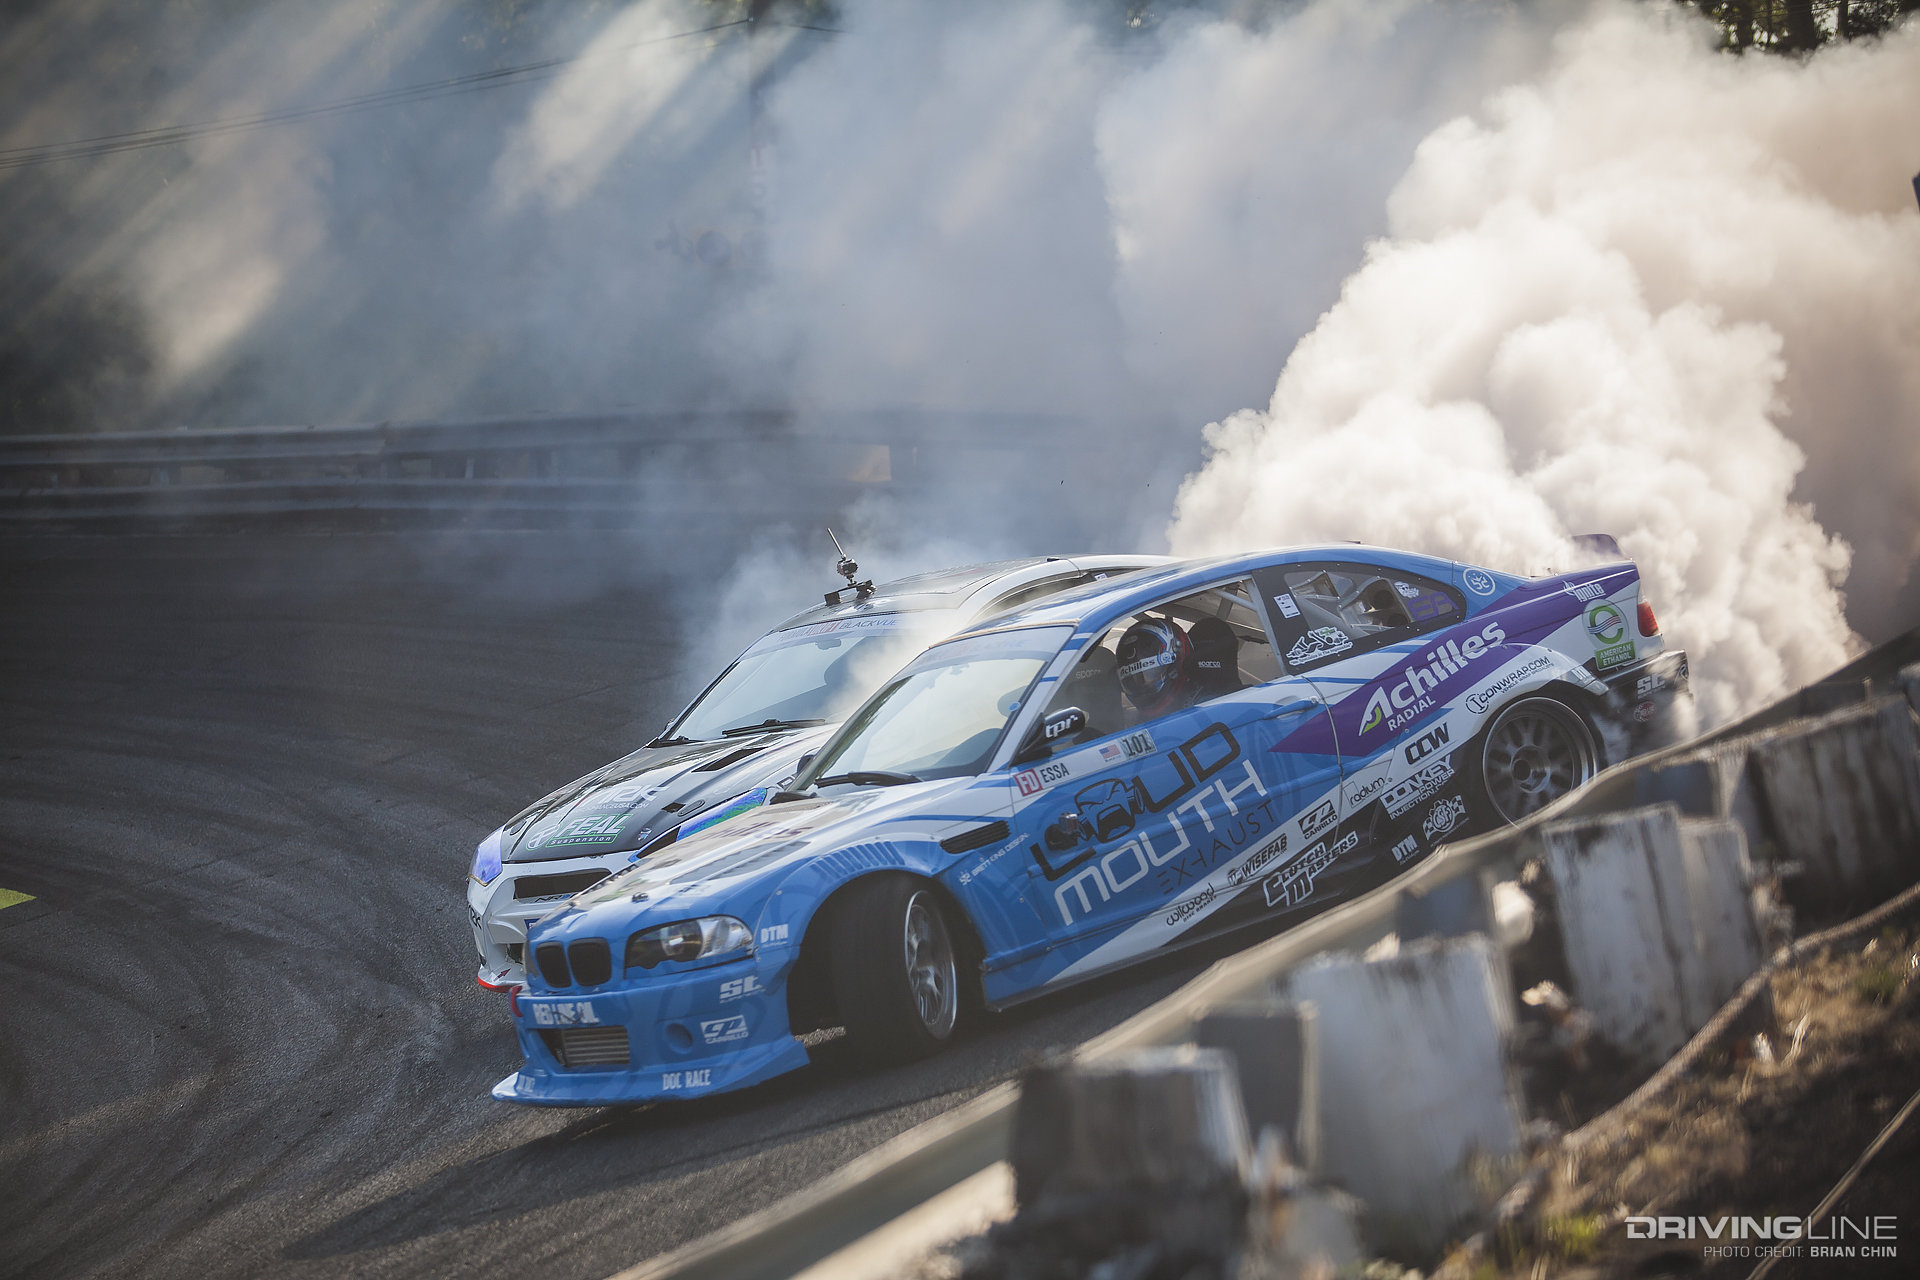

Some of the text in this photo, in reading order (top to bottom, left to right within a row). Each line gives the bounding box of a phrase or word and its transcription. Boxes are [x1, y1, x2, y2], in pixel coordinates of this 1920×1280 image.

[839, 620, 898, 629] BLACKVUE
[1600, 643, 1632, 659] AMERICAN
[1603, 652, 1632, 666] ETHANOL
[1120, 659, 1156, 677] Achilles
[1358, 621, 1506, 736] Achilles
[1501, 680, 1518, 694] VEHICLE
[1387, 695, 1436, 731] RADIAL
[1123, 734, 1151, 757] 101
[1404, 721, 1450, 765] CCW
[1017, 763, 1070, 794] FD ESSA
[1349, 777, 1386, 806] radium
[1380, 754, 1452, 809] DONKEY
[1419, 768, 1455, 794] POWER
[556, 815, 627, 838] FEAL
[1304, 815, 1338, 840] CARRILLO
[550, 836, 612, 846] Suspension
[1054, 759, 1267, 926] MOUTH
[1156, 799, 1275, 896] EXHAUST
[1391, 834, 1418, 861] DTM
[1241, 835, 1288, 877] WISEFAB
[1284, 831, 1358, 907] MASTERS
[1263, 841, 1326, 908] CLUTCH
[1166, 882, 1215, 926] wilwood
[761, 924, 788, 943] DTM
[662, 1069, 711, 1091] DOC RACE
